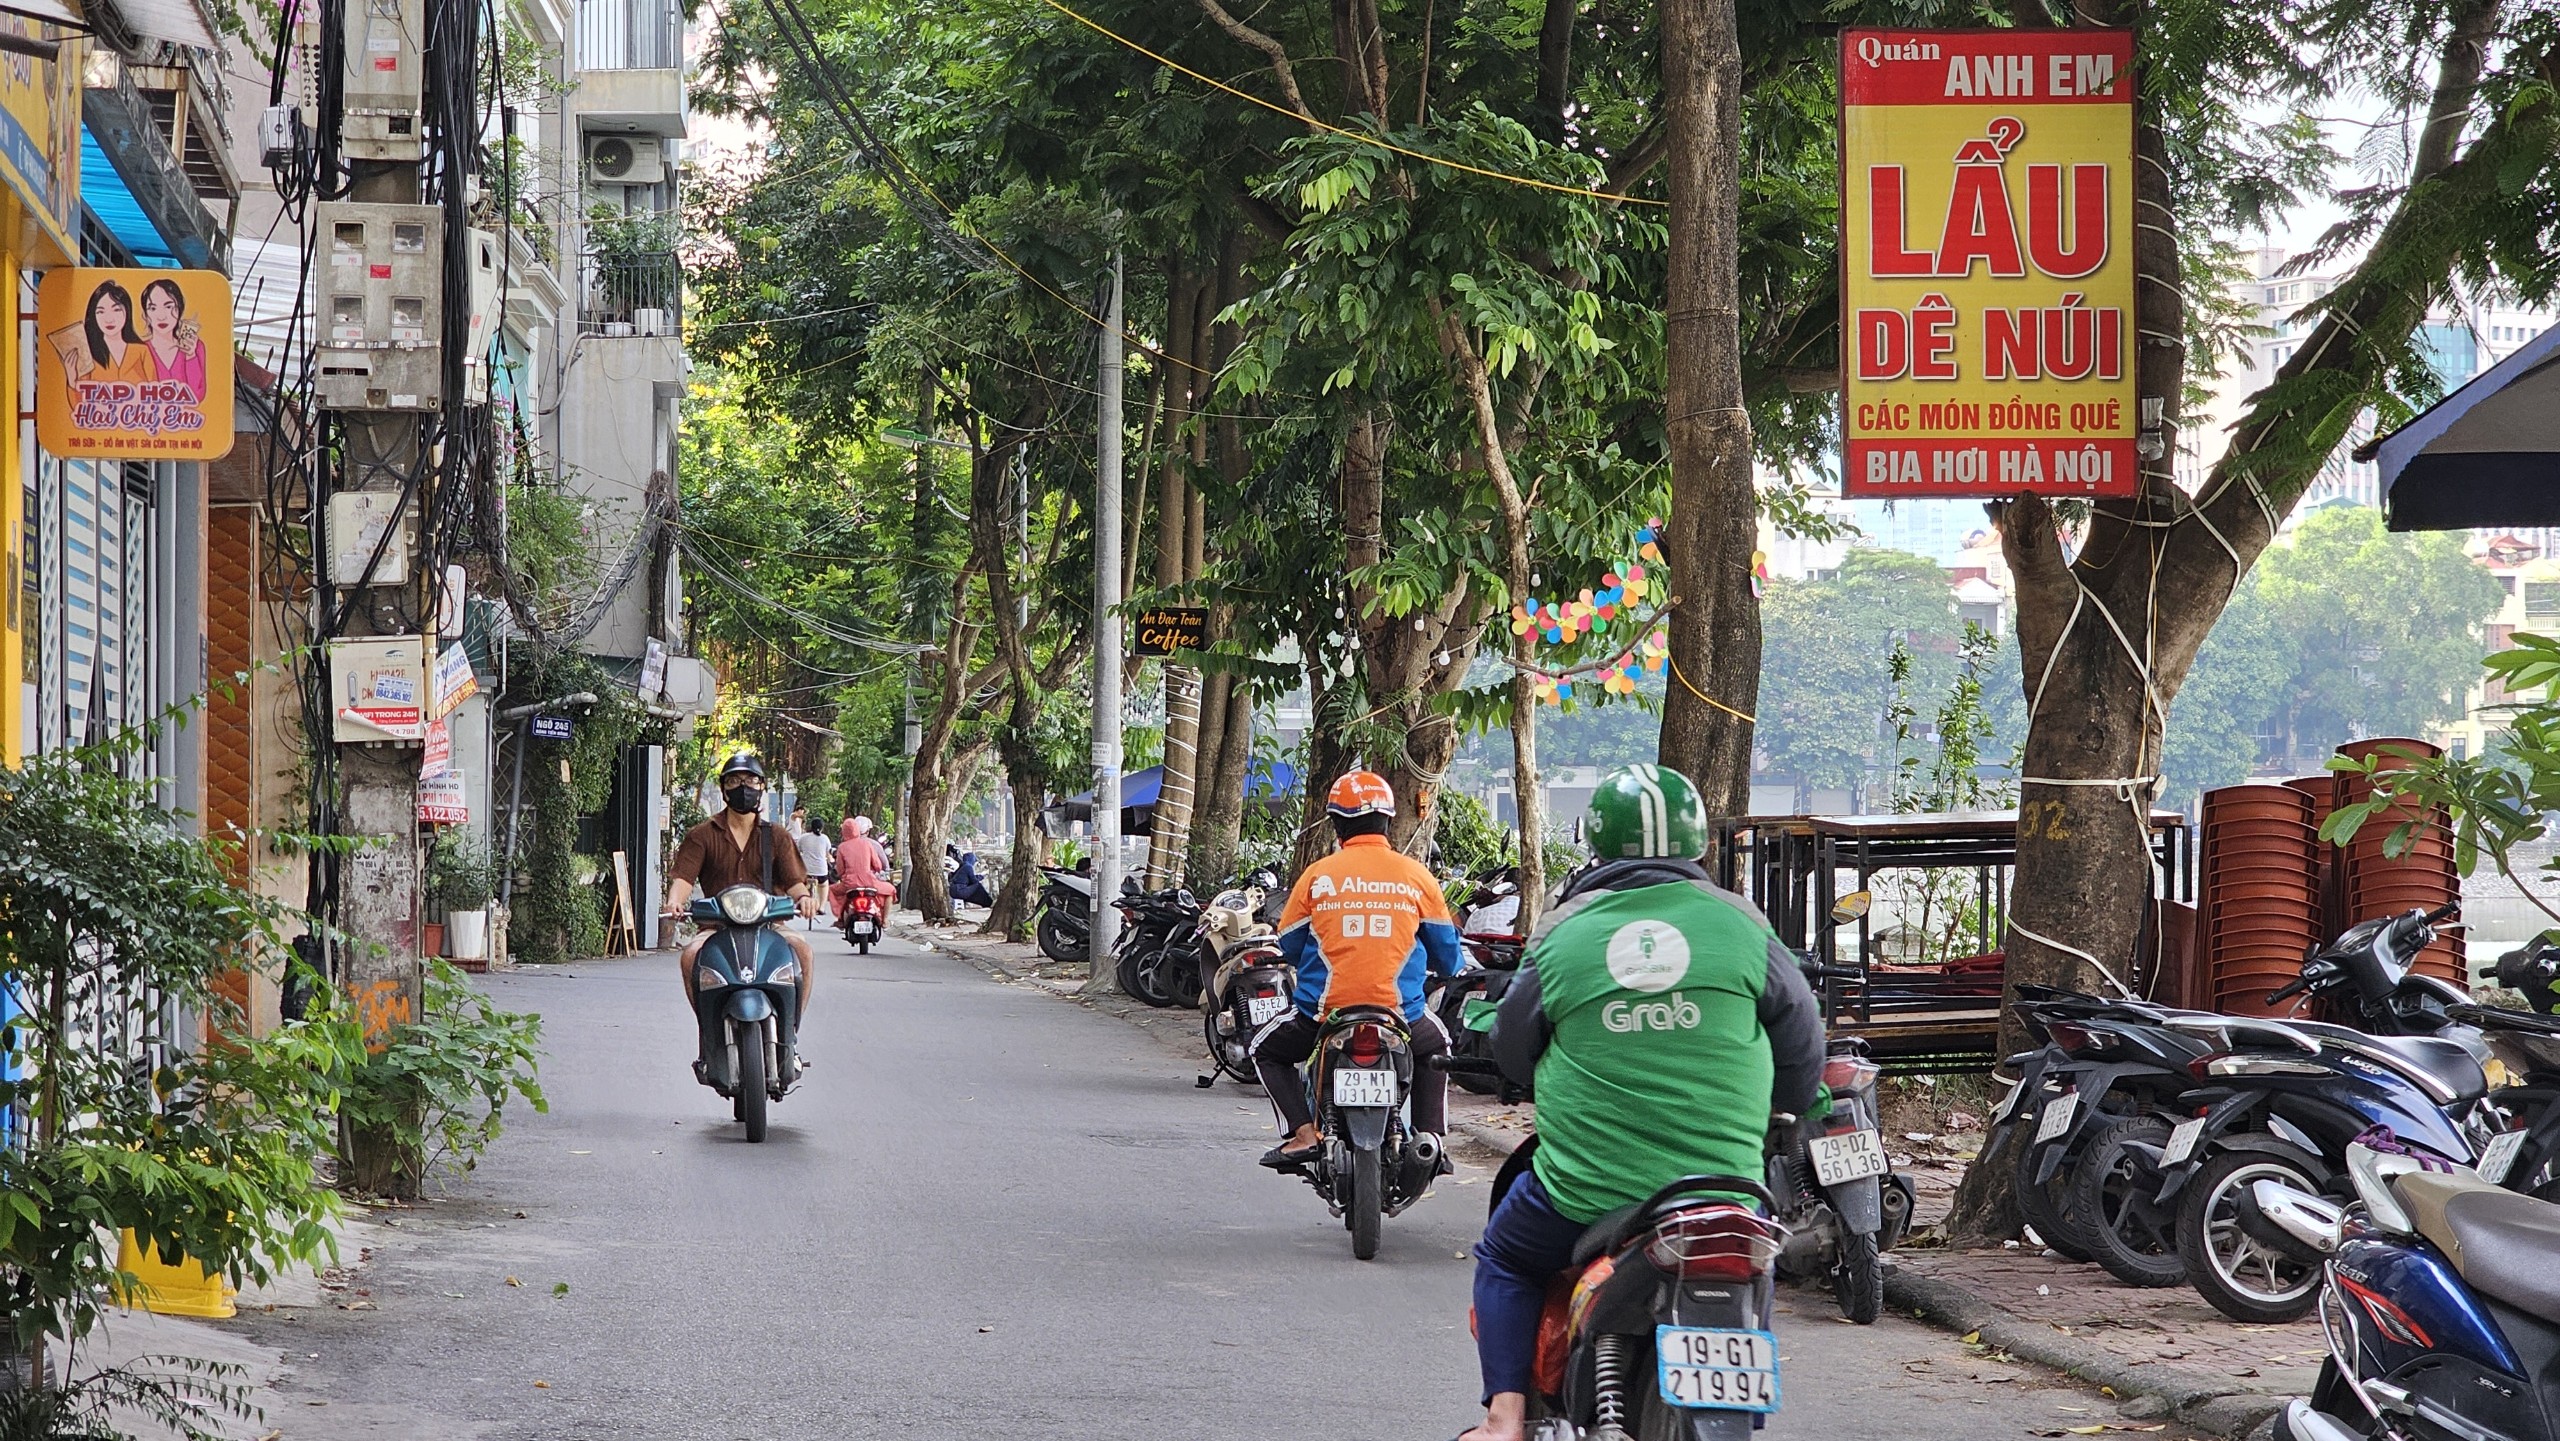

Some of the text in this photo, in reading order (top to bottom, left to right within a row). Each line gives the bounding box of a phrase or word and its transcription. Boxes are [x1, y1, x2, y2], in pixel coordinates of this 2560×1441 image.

[1858, 37, 2114, 97] Quán ANH EM
[1869, 115, 2109, 279] LẨU
[1857, 291, 2121, 381] DÊ NÚI
[79, 384, 134, 403] TẠP
[74, 403, 203, 435] Hai Chị Em
[1858, 394, 2121, 433] CÁC MÓN ĐỒNG QUÊ
[1866, 443, 2112, 490] BIA HƠI HÀ NỘI
[1141, 628, 1200, 651] Coffee
[1343, 901, 1364, 909] CAO
[1365, 901, 1392, 910] GIAO
[1602, 992, 1701, 1033] Grab
[1344, 1072, 1386, 1087] 29-N1
[1339, 1088, 1392, 1104] 031.21
[1820, 1133, 1870, 1160] 29-D2
[1820, 1152, 1881, 1182] 561.36
[1681, 1335, 1756, 1368] 19-G1
[1669, 1369, 1770, 1406] 219.94
